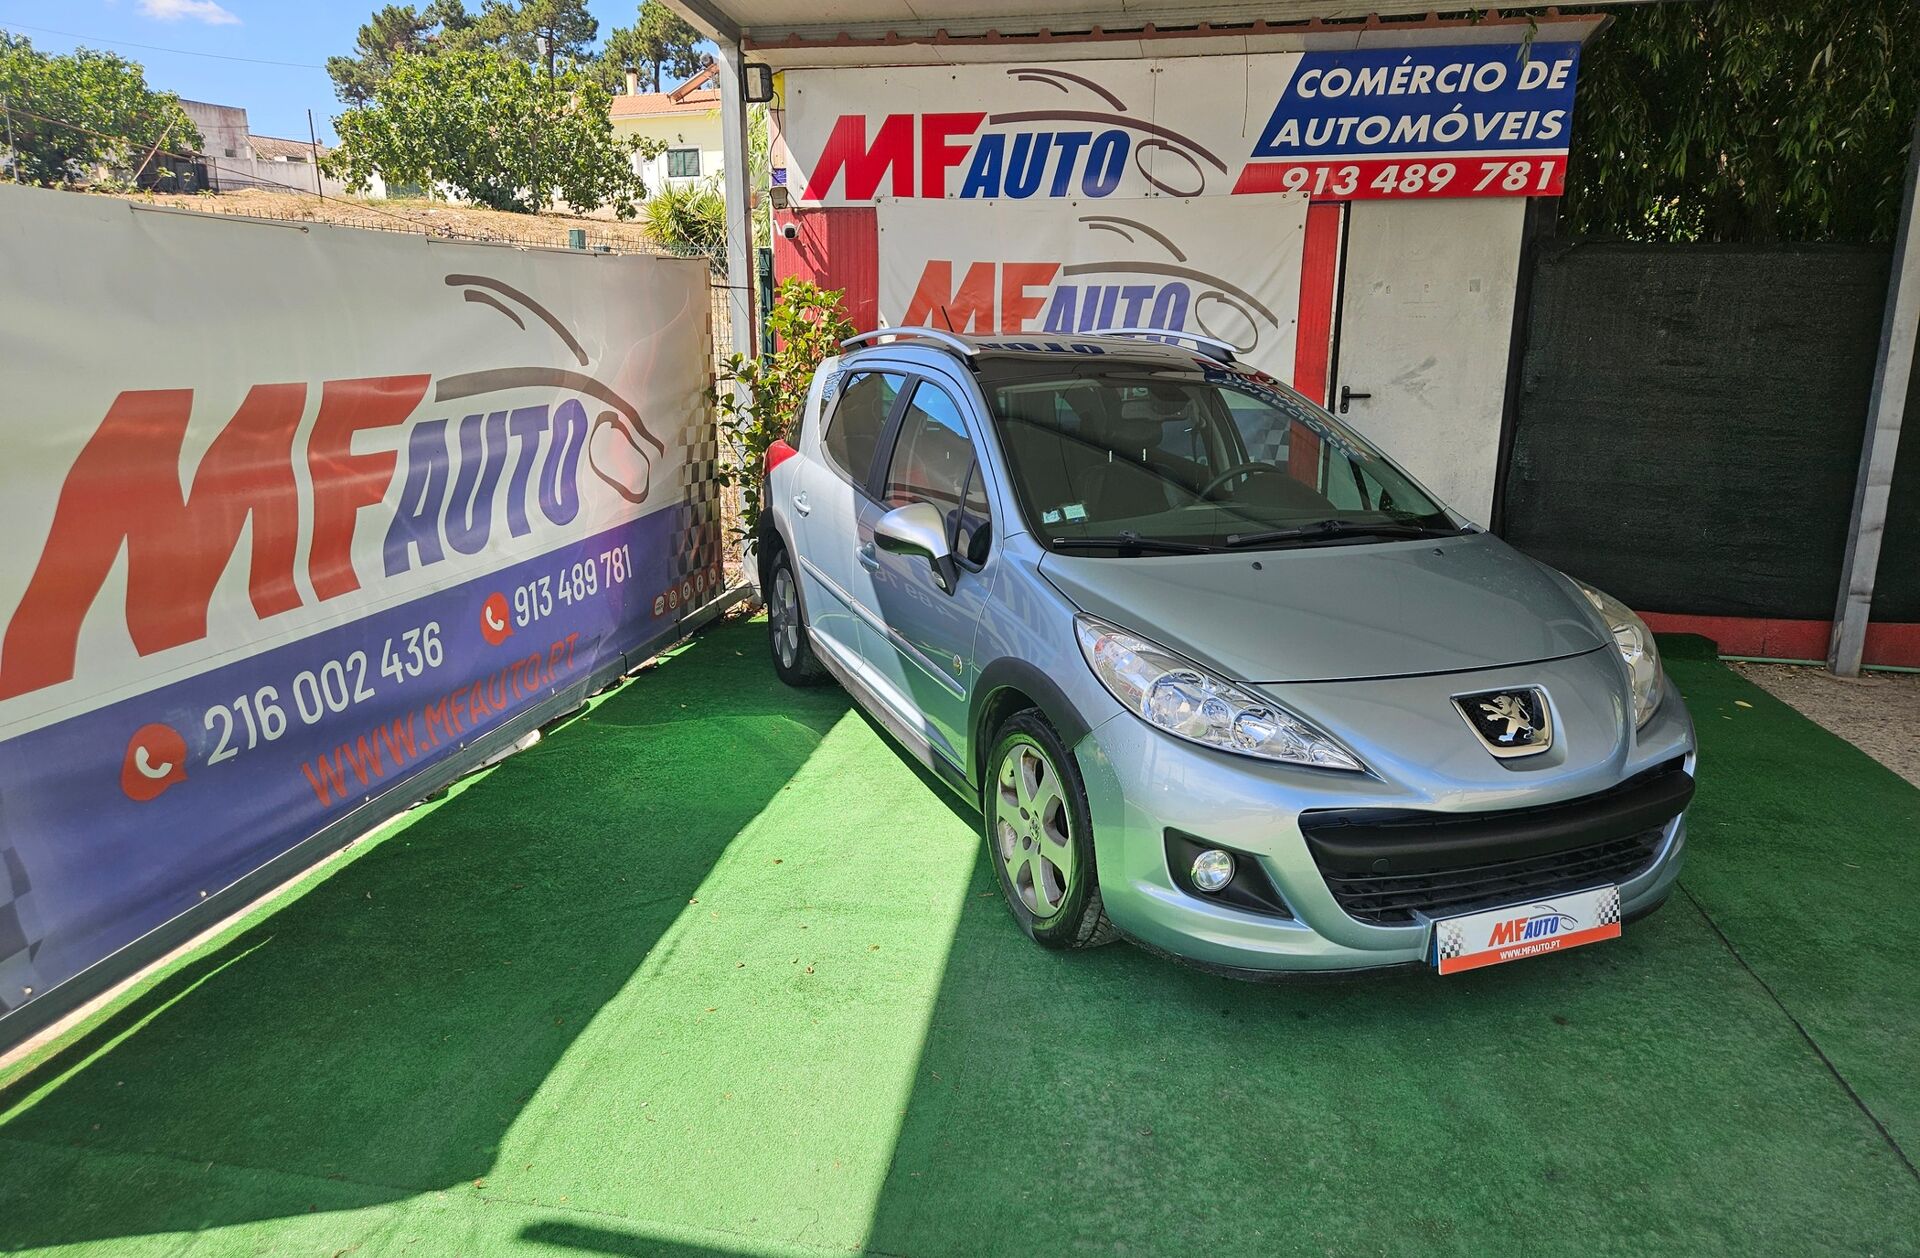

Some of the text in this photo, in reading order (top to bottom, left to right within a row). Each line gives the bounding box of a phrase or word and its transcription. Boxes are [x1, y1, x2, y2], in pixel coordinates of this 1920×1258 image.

[1296, 56, 1572, 98] COMÉRCIO DE
[1270, 103, 1566, 148] AUTOMÓVEIS
[1282, 161, 1556, 195] 913 489 781
[513, 544, 633, 628] 913 489 781
[205, 620, 444, 765] 216 002 436
[302, 633, 578, 807] WWW.MFAUTO.PT
[1499, 939, 1561, 960] WWW.MFAUTO.PT
